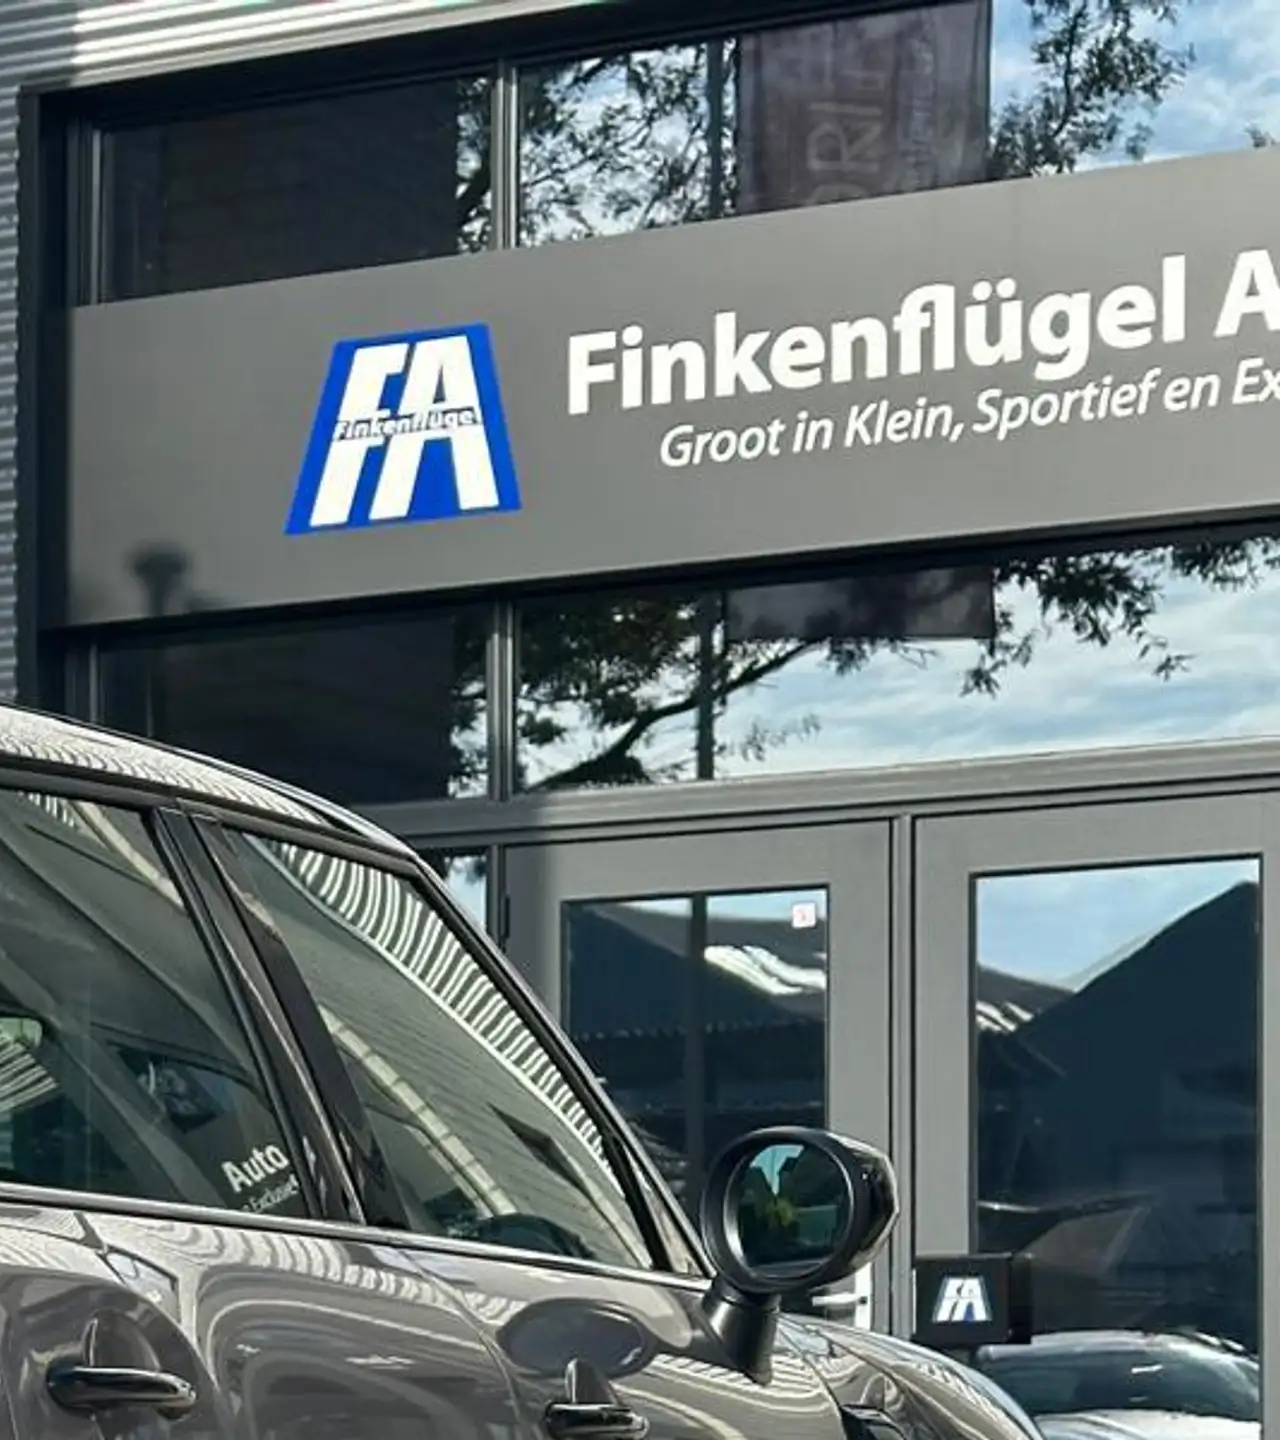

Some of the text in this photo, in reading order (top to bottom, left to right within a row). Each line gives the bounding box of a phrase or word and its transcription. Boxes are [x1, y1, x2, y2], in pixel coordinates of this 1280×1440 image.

[567, 254, 1185, 415] Finkenflügel
[659, 424, 786, 467] Groot
[792, 410, 835, 453] in
[844, 397, 964, 448] Klein,
[972, 366, 1162, 441] Sportief
[1163, 373, 1221, 412] en
[221, 1145, 289, 1192] Auto
